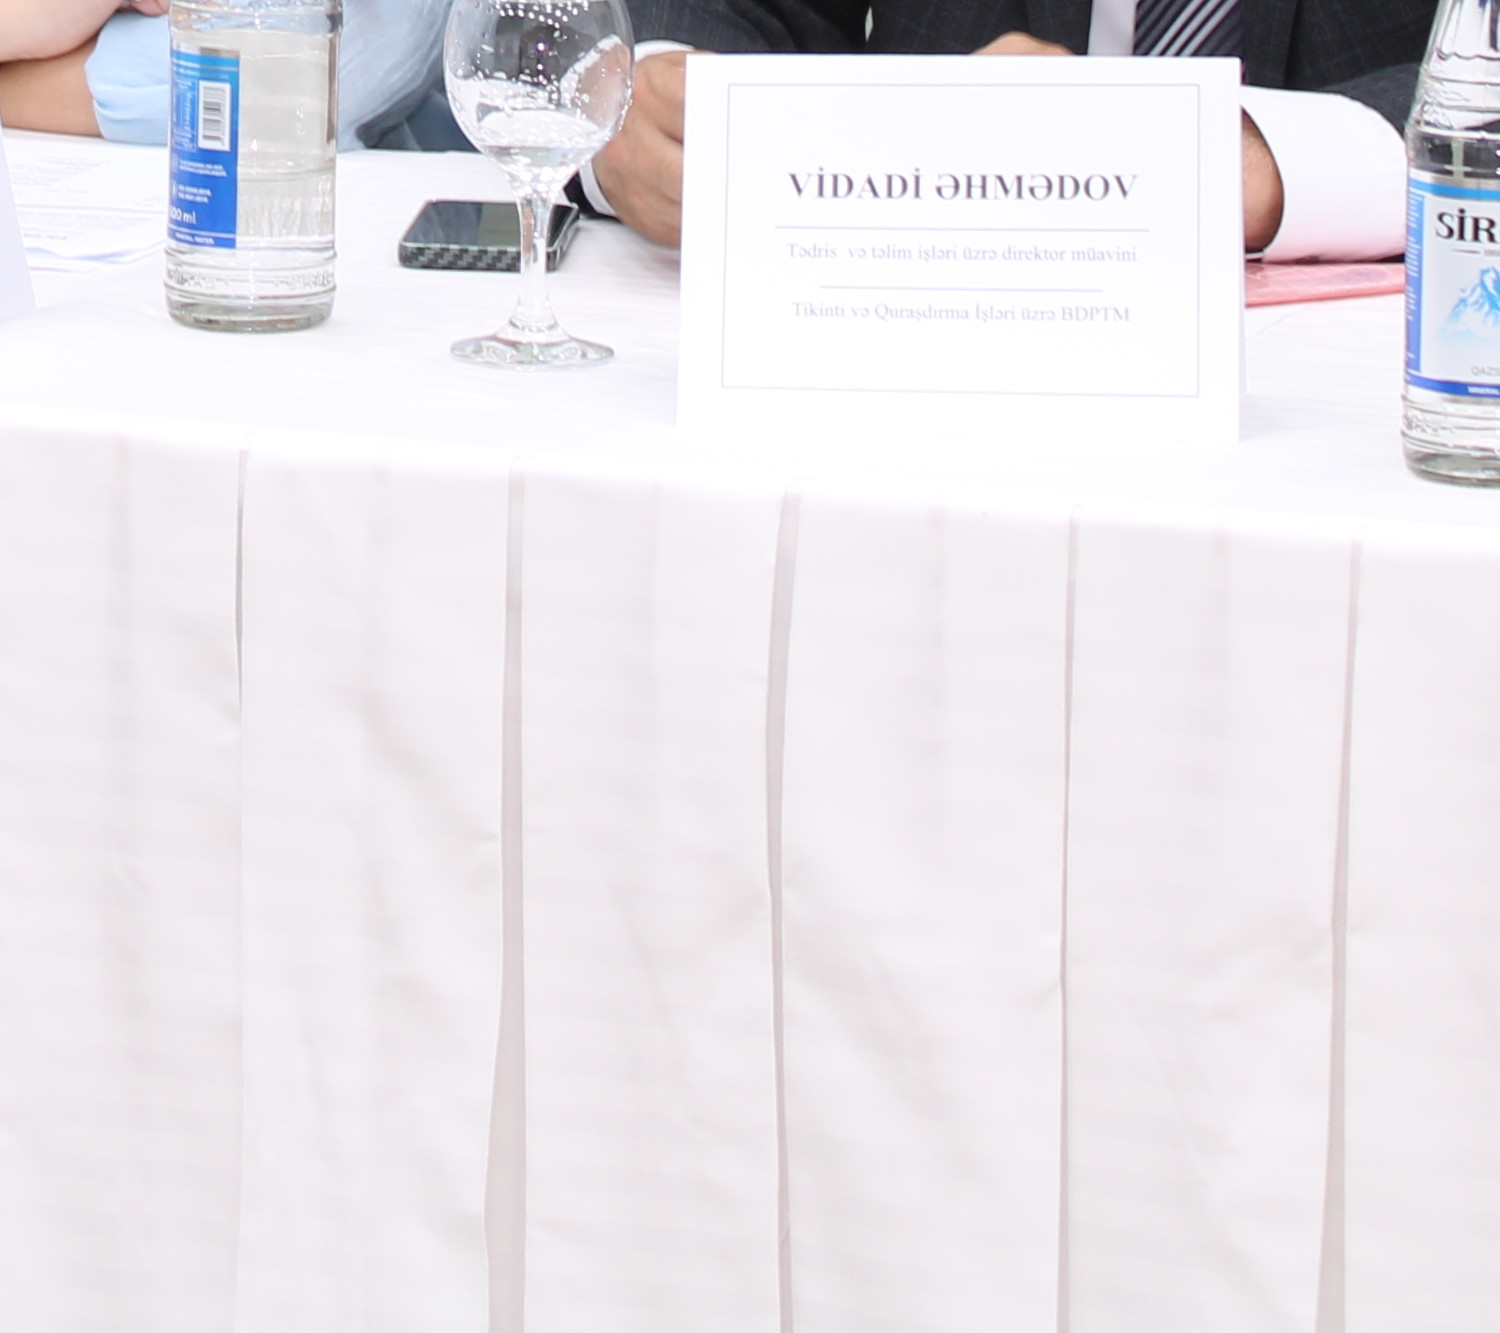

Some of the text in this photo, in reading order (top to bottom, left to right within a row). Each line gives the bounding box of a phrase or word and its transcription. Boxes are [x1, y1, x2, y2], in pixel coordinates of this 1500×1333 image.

[788, 166, 1138, 201] VİDADİ ƏHMƏDOV
[183, 210, 197, 224] ml
[786, 243, 1137, 262] Tədris və təlim işləri üzrə direktor müavini
[792, 302, 1130, 323] Tikinti və Quraşdırma İşləri üzrə BDPTM
